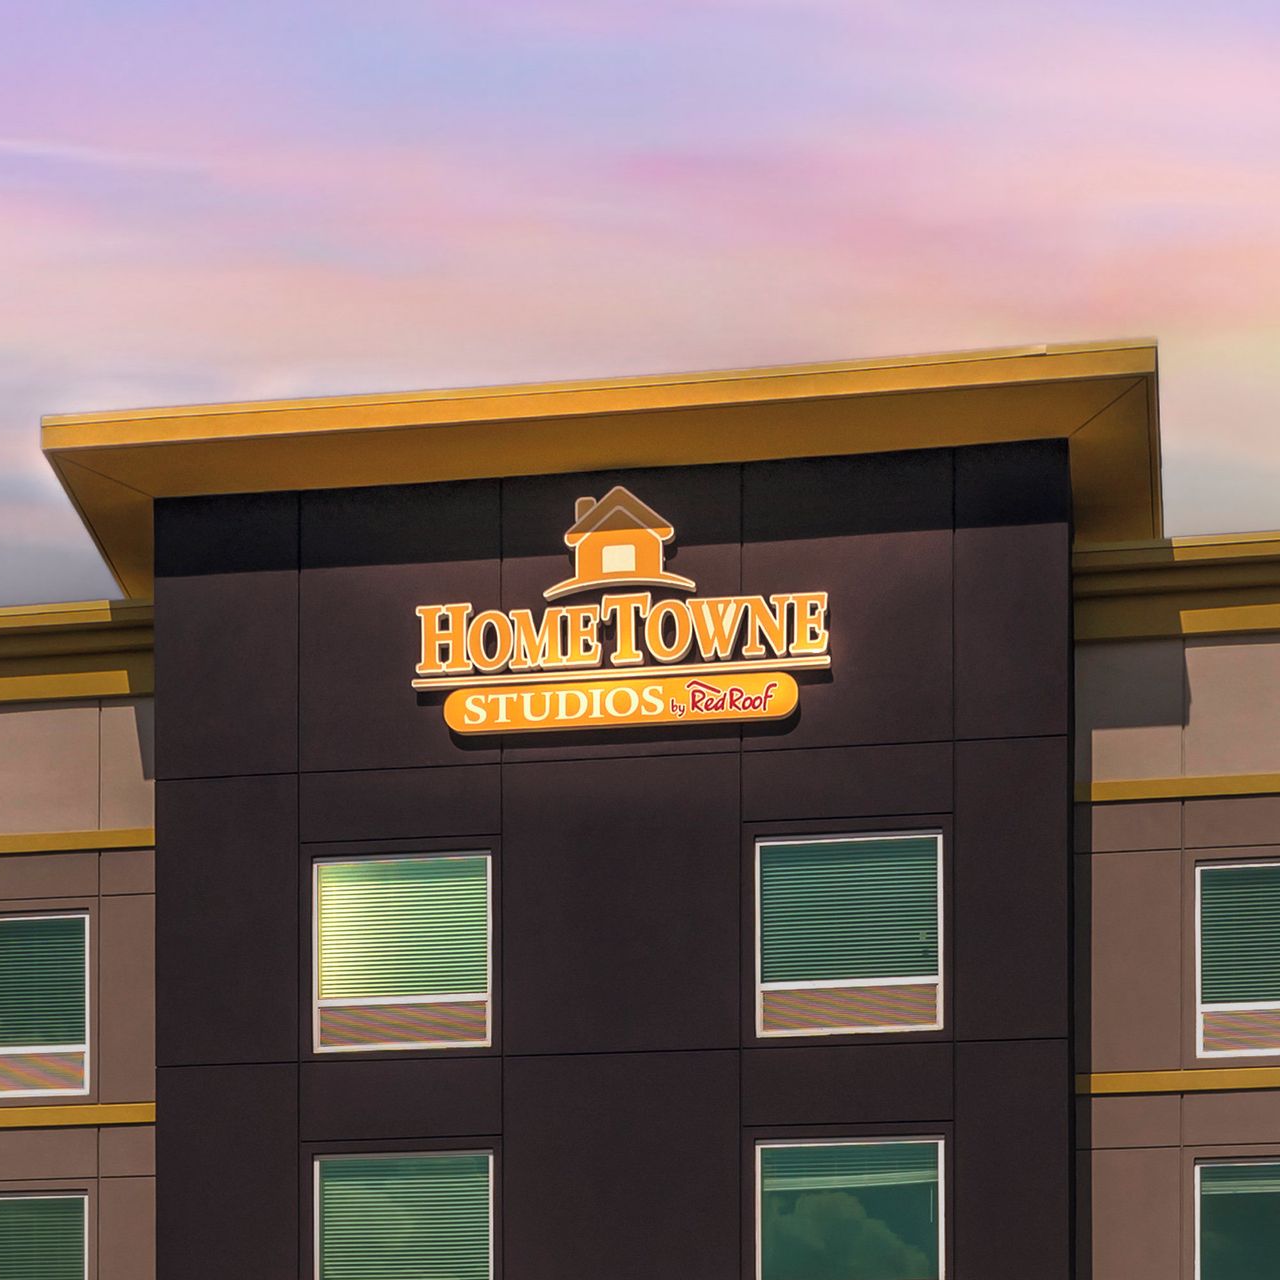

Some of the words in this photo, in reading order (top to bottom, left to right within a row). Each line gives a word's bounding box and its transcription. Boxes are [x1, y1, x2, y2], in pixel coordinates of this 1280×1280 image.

[463, 685, 665, 725] STUDIOS
[670, 698, 686, 717] by
[690, 689, 727, 712] Red
[729, 683, 778, 711] Roof
